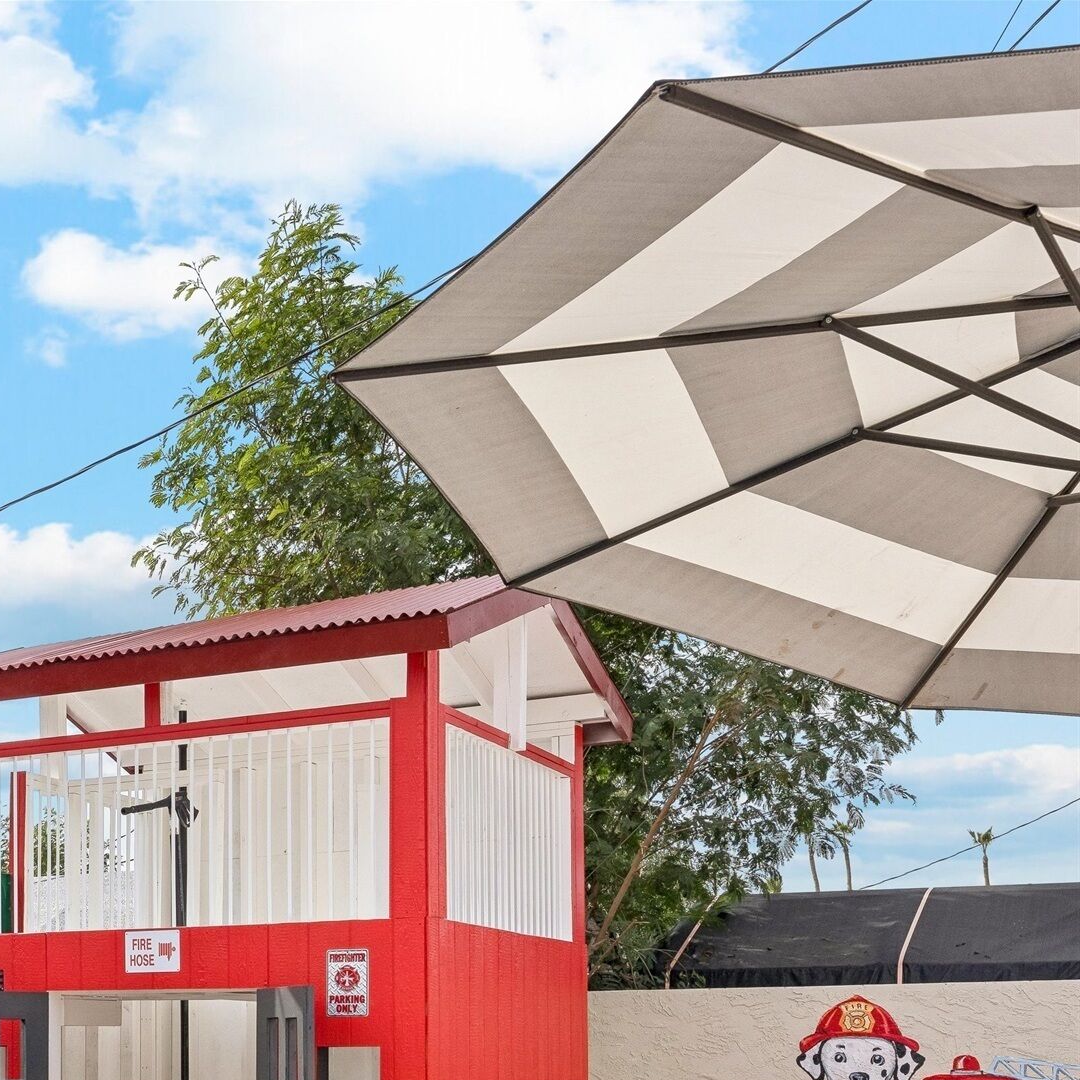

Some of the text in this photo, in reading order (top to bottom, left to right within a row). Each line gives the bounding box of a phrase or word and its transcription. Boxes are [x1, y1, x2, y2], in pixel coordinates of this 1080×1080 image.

[132, 938, 152, 950] FIRE
[130, 954, 155, 967] HOSE
[329, 953, 366, 963] FIREFIGHTER
[329, 994, 366, 1004] PARKING
[336, 1004, 358, 1013] ONLY
[845, 1003, 868, 1011] FIRE
